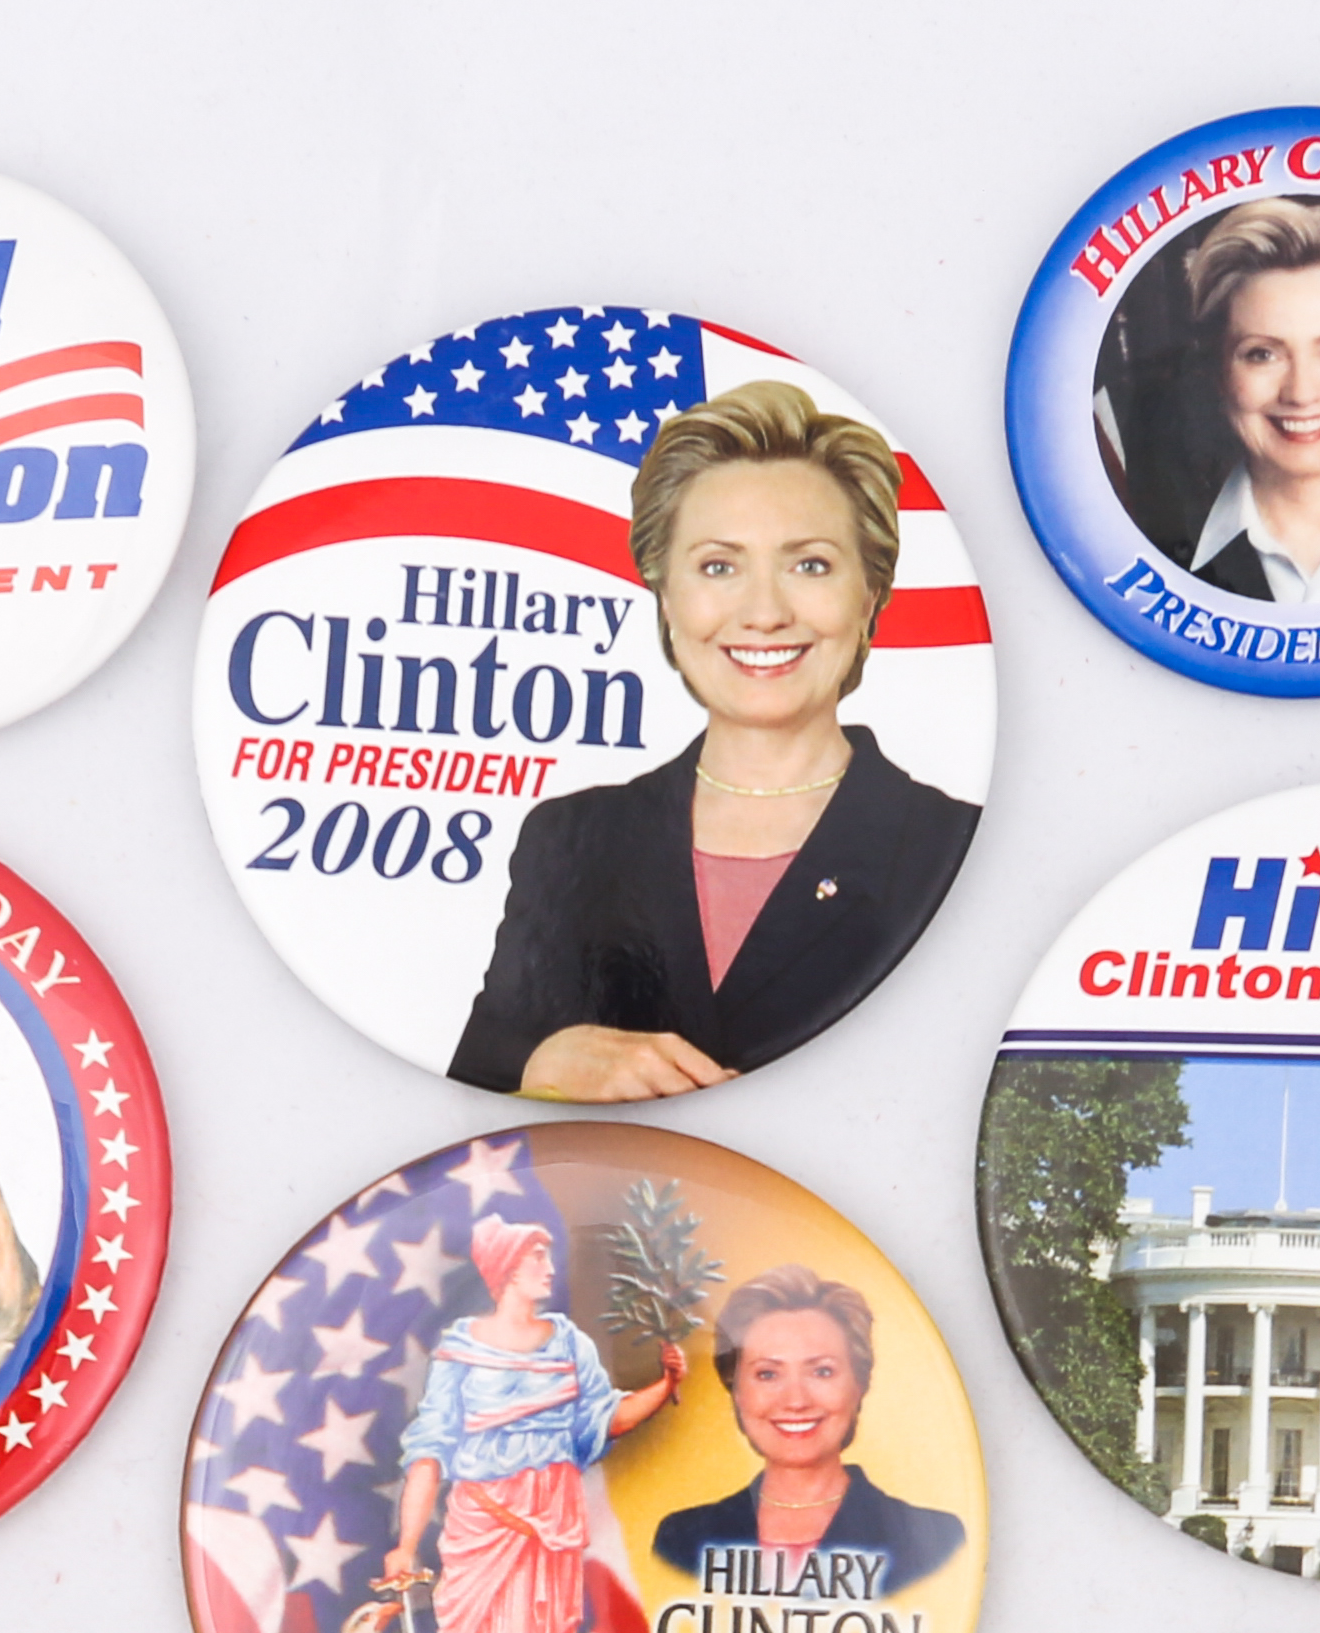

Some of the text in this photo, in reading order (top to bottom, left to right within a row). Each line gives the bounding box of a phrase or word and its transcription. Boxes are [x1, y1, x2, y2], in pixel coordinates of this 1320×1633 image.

[1070, 144, 1275, 298] HILLARY
[399, 563, 634, 655] Hillary
[227, 610, 647, 750] Clinton
[231, 736, 557, 799] FOR PRESIDENT
[245, 797, 493, 884] 2008
[703, 1547, 884, 1600] HILLARY
